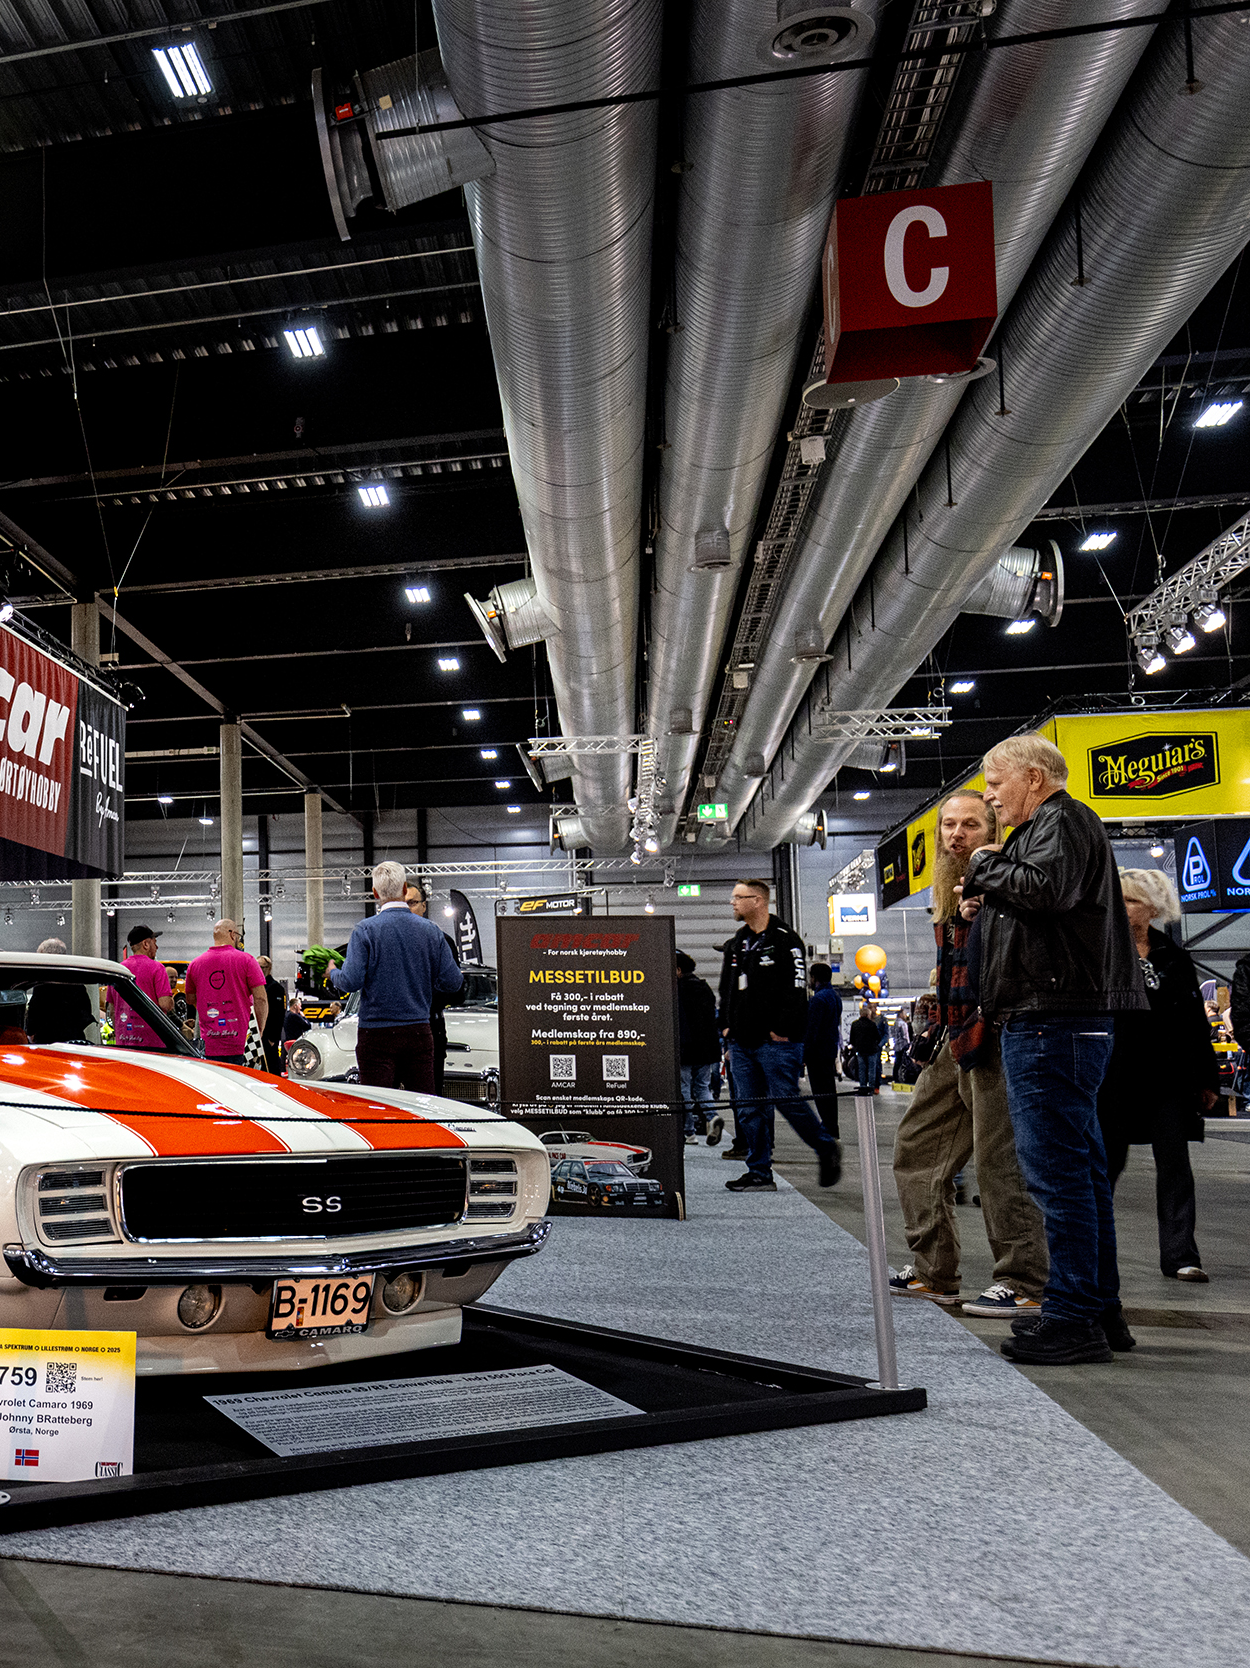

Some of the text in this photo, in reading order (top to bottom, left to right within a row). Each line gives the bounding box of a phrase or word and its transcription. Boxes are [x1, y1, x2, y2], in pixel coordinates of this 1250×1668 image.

[884, 205, 949, 308] C
[1099, 738, 1206, 790] Meguiar's
[546, 900, 575, 909] MOTOR
[530, 933, 640, 949] amcar
[579, 949, 627, 957] kjøretøyhobby
[529, 970, 645, 984] MESSETILBUD
[551, 992, 562, 1001] Få
[564, 993, 588, 1002] 300,-
[596, 993, 624, 1001] rabatt
[526, 1003, 542, 1011] ved
[544, 1003, 577, 1013] tegning
[593, 1003, 650, 1013] medlemskap
[563, 1013, 613, 1021] første året.
[532, 1029, 645, 1040] Medlemskap fra 890,-
[302, 1196, 342, 1213] SS
[274, 1281, 371, 1319] B-1169
[299, 1325, 362, 1337] CAMARO
[213, 1398, 242, 1406] 1969
[244, 1392, 302, 1403] Chevrolet
[303, 1388, 350, 1398] Camaro
[351, 1384, 389, 1394] SS/RS
[389, 1379, 453, 1389] Convertible
[462, 1375, 489, 1384] Indy
[536, 1368, 556, 1376] Car
[29, 1399, 67, 1409] Camaro
[71, 1401, 93, 1410] 1969
[37, 1414, 92, 1427] BRatteberg
[9, 1426, 59, 1436] Ørsta, Norge
